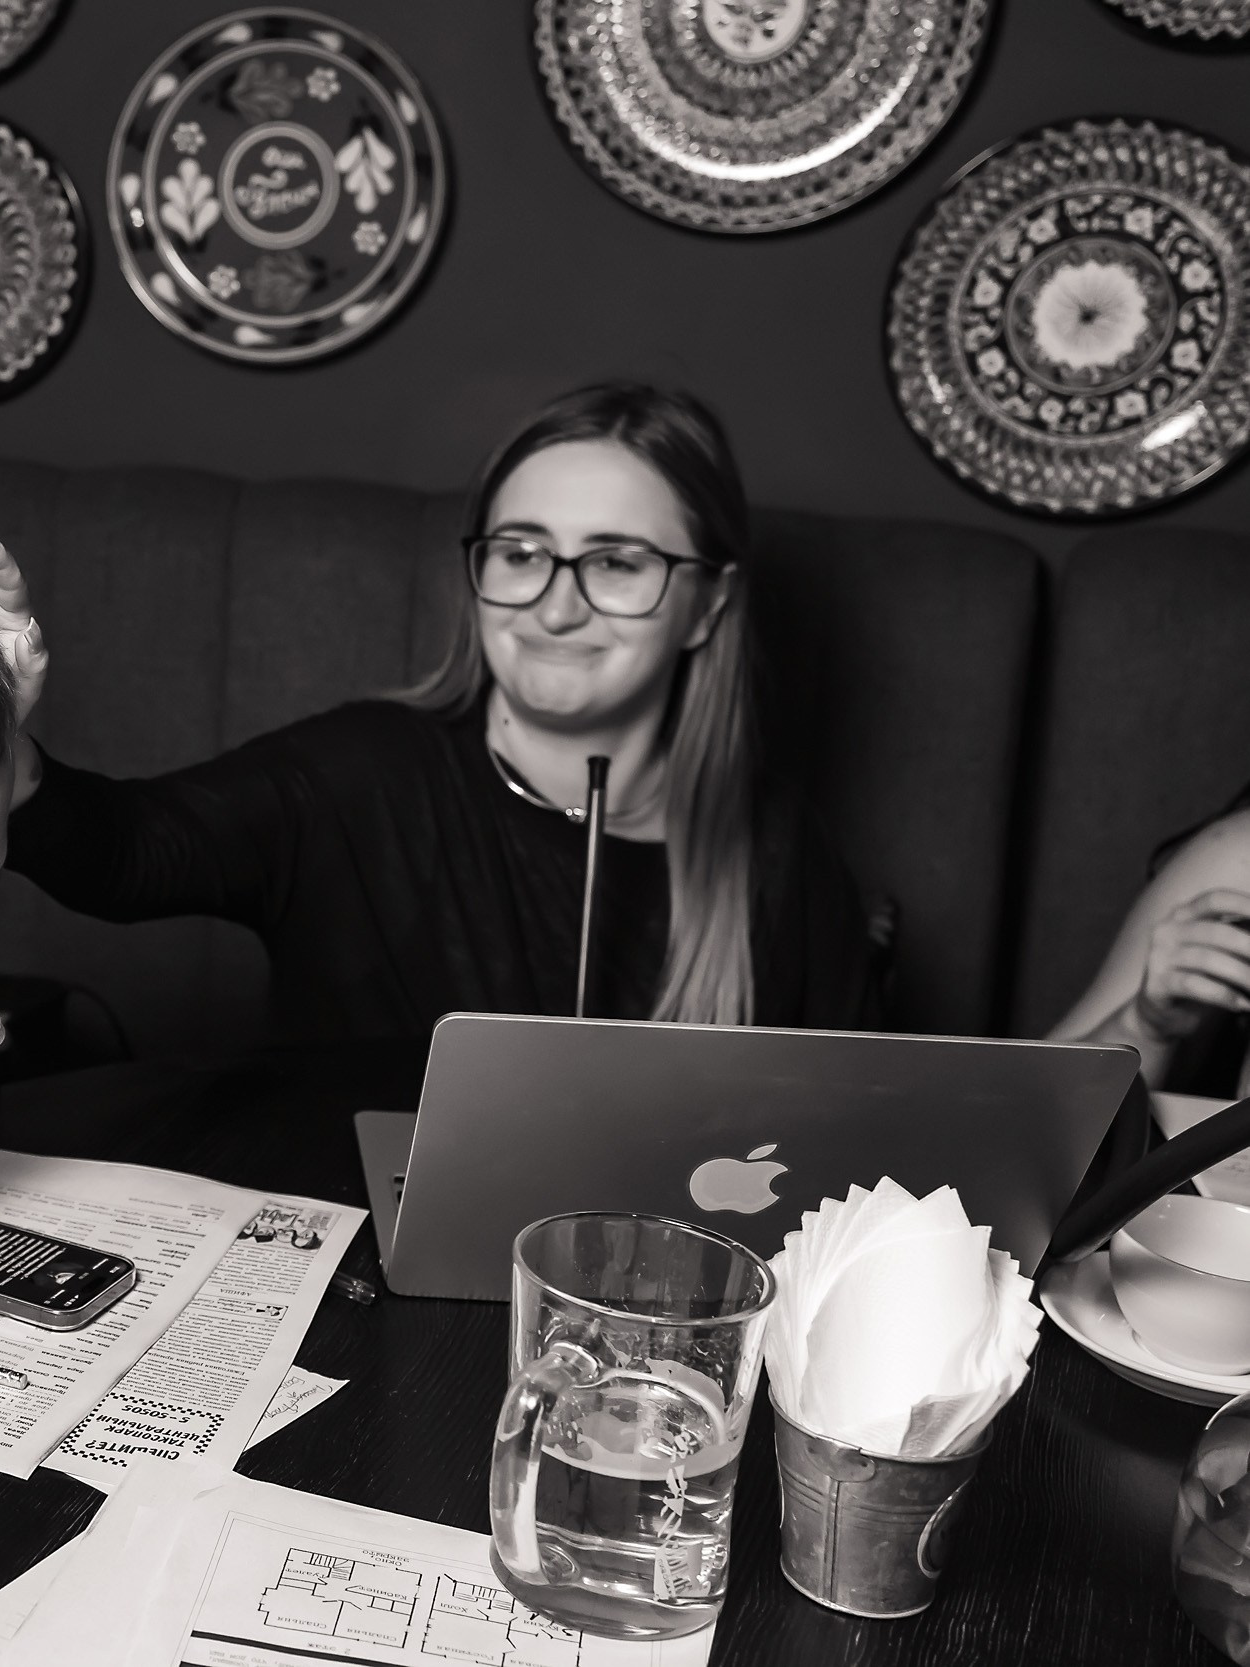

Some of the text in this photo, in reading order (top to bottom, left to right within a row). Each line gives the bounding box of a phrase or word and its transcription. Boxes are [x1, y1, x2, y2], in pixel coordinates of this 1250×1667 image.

[145, 1351, 175, 1360] ярмарк
[93, 1413, 201, 1443] ЦЕНТРАЛЬНЫЙ
[103, 1425, 186, 1448] ТАКСОПАРК
[284, 1568, 327, 1580] Туалет
[358, 1585, 408, 1601] Кабинет
[440, 1602, 468, 1613] Холл
[276, 1616, 327, 1629] Спальня
[347, 1628, 398, 1642] Спальня
